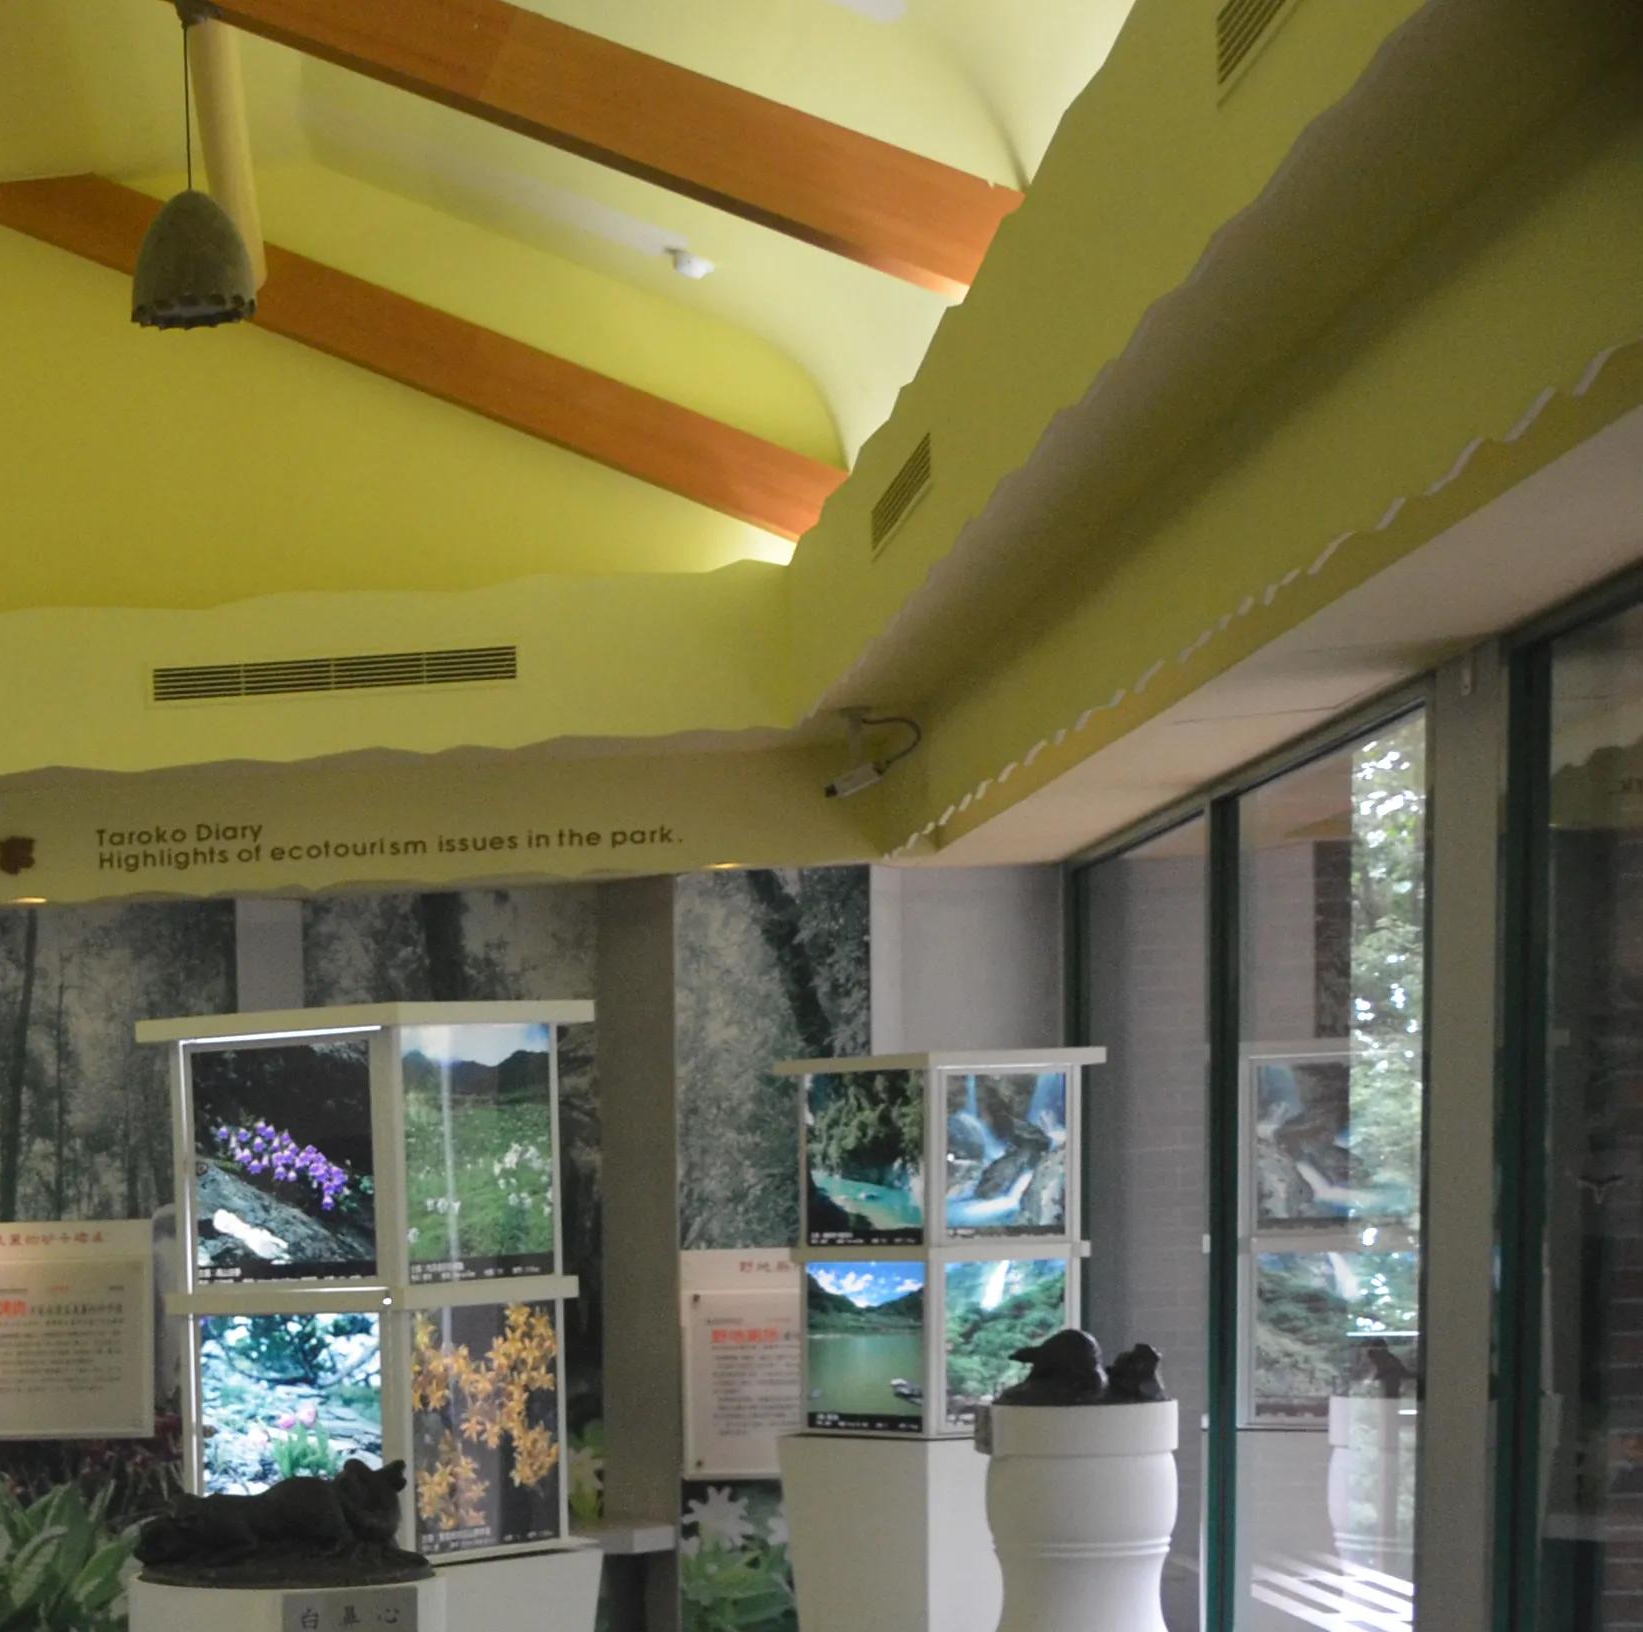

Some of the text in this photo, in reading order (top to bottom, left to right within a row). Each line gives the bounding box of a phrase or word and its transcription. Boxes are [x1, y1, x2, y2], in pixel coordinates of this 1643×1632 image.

[97, 823, 263, 846] Taroko Diary
[99, 824, 683, 872] Highlights of ecotourism issues in the park.
